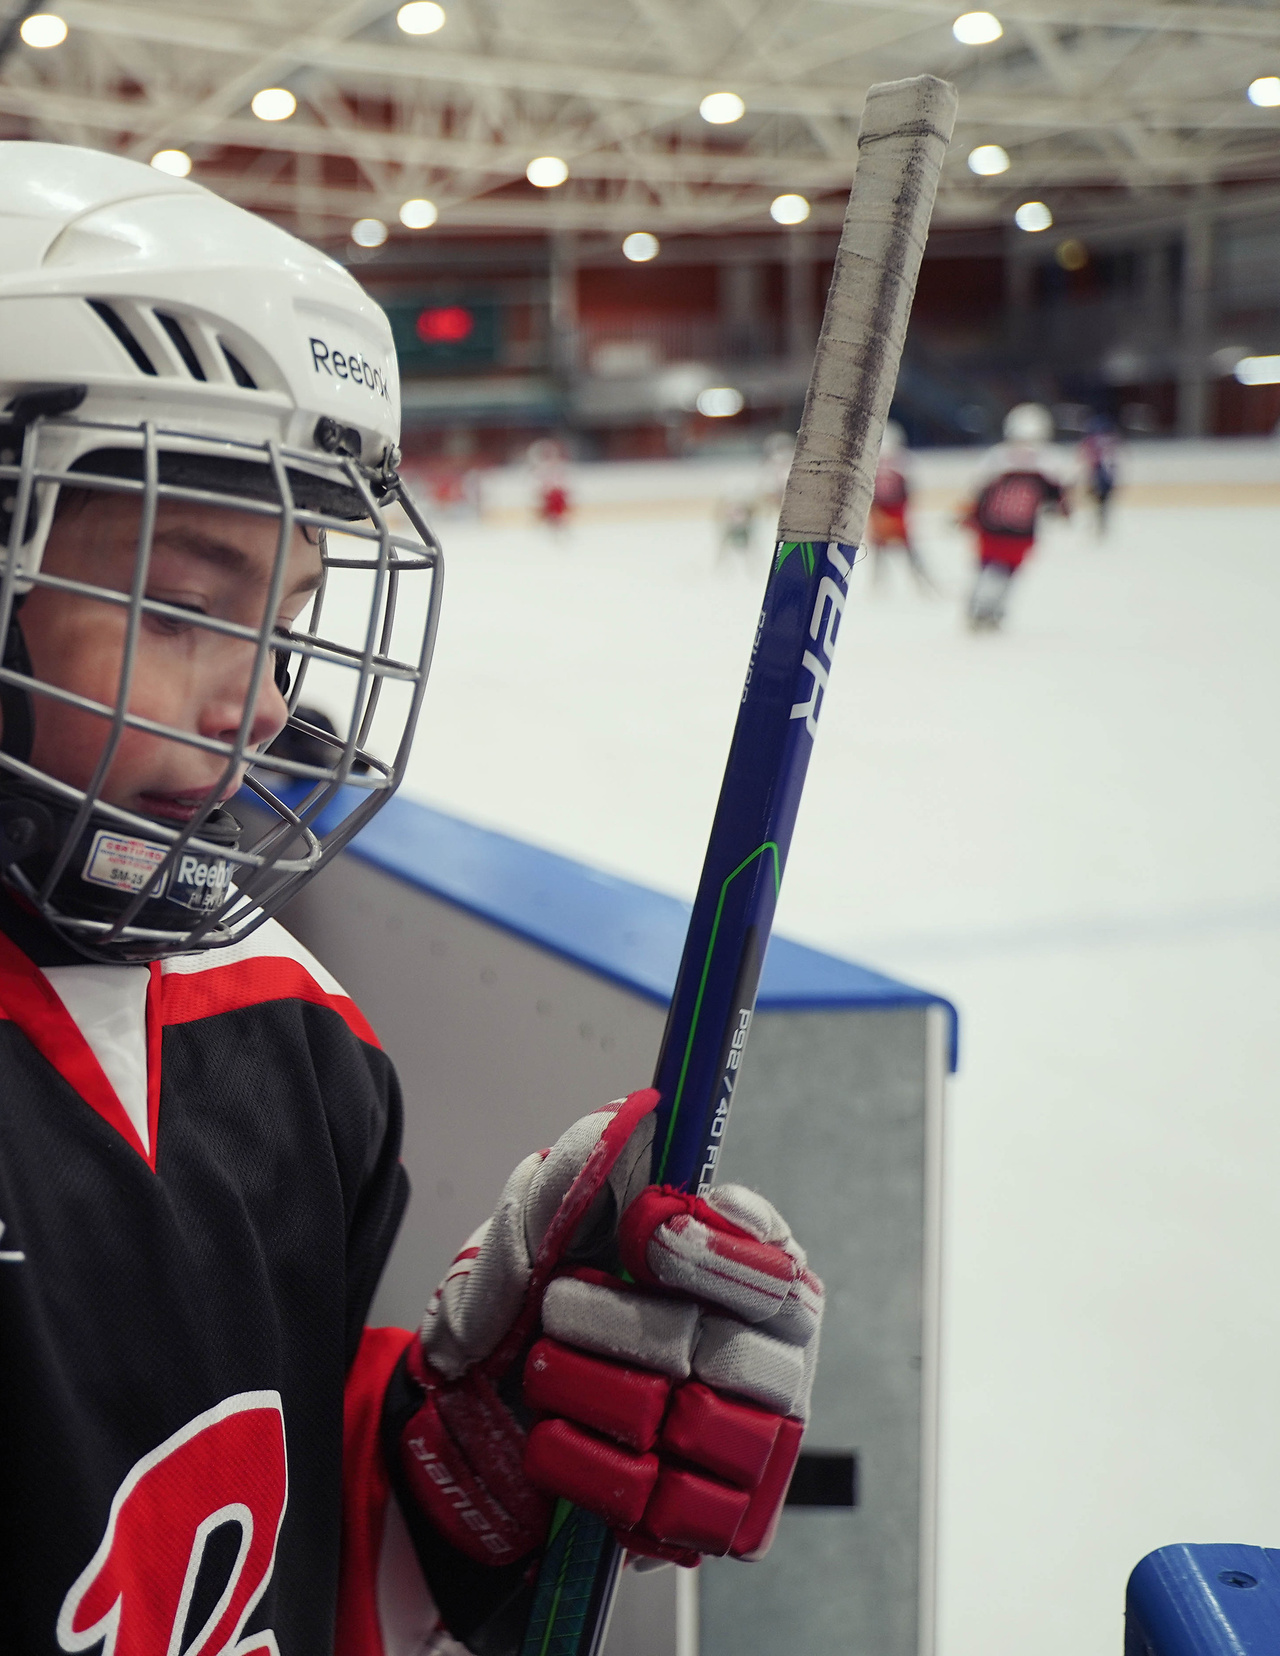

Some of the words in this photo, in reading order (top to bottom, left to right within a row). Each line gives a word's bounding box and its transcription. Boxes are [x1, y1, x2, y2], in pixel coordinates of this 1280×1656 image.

[309, 337, 391, 405] Reebok
[110, 868, 144, 884] SM-25
[726, 1009, 752, 1070] P92
[711, 1097, 728, 1138] 40
[696, 1145, 719, 1198] FLE
[408, 1437, 513, 1554] BAUER
